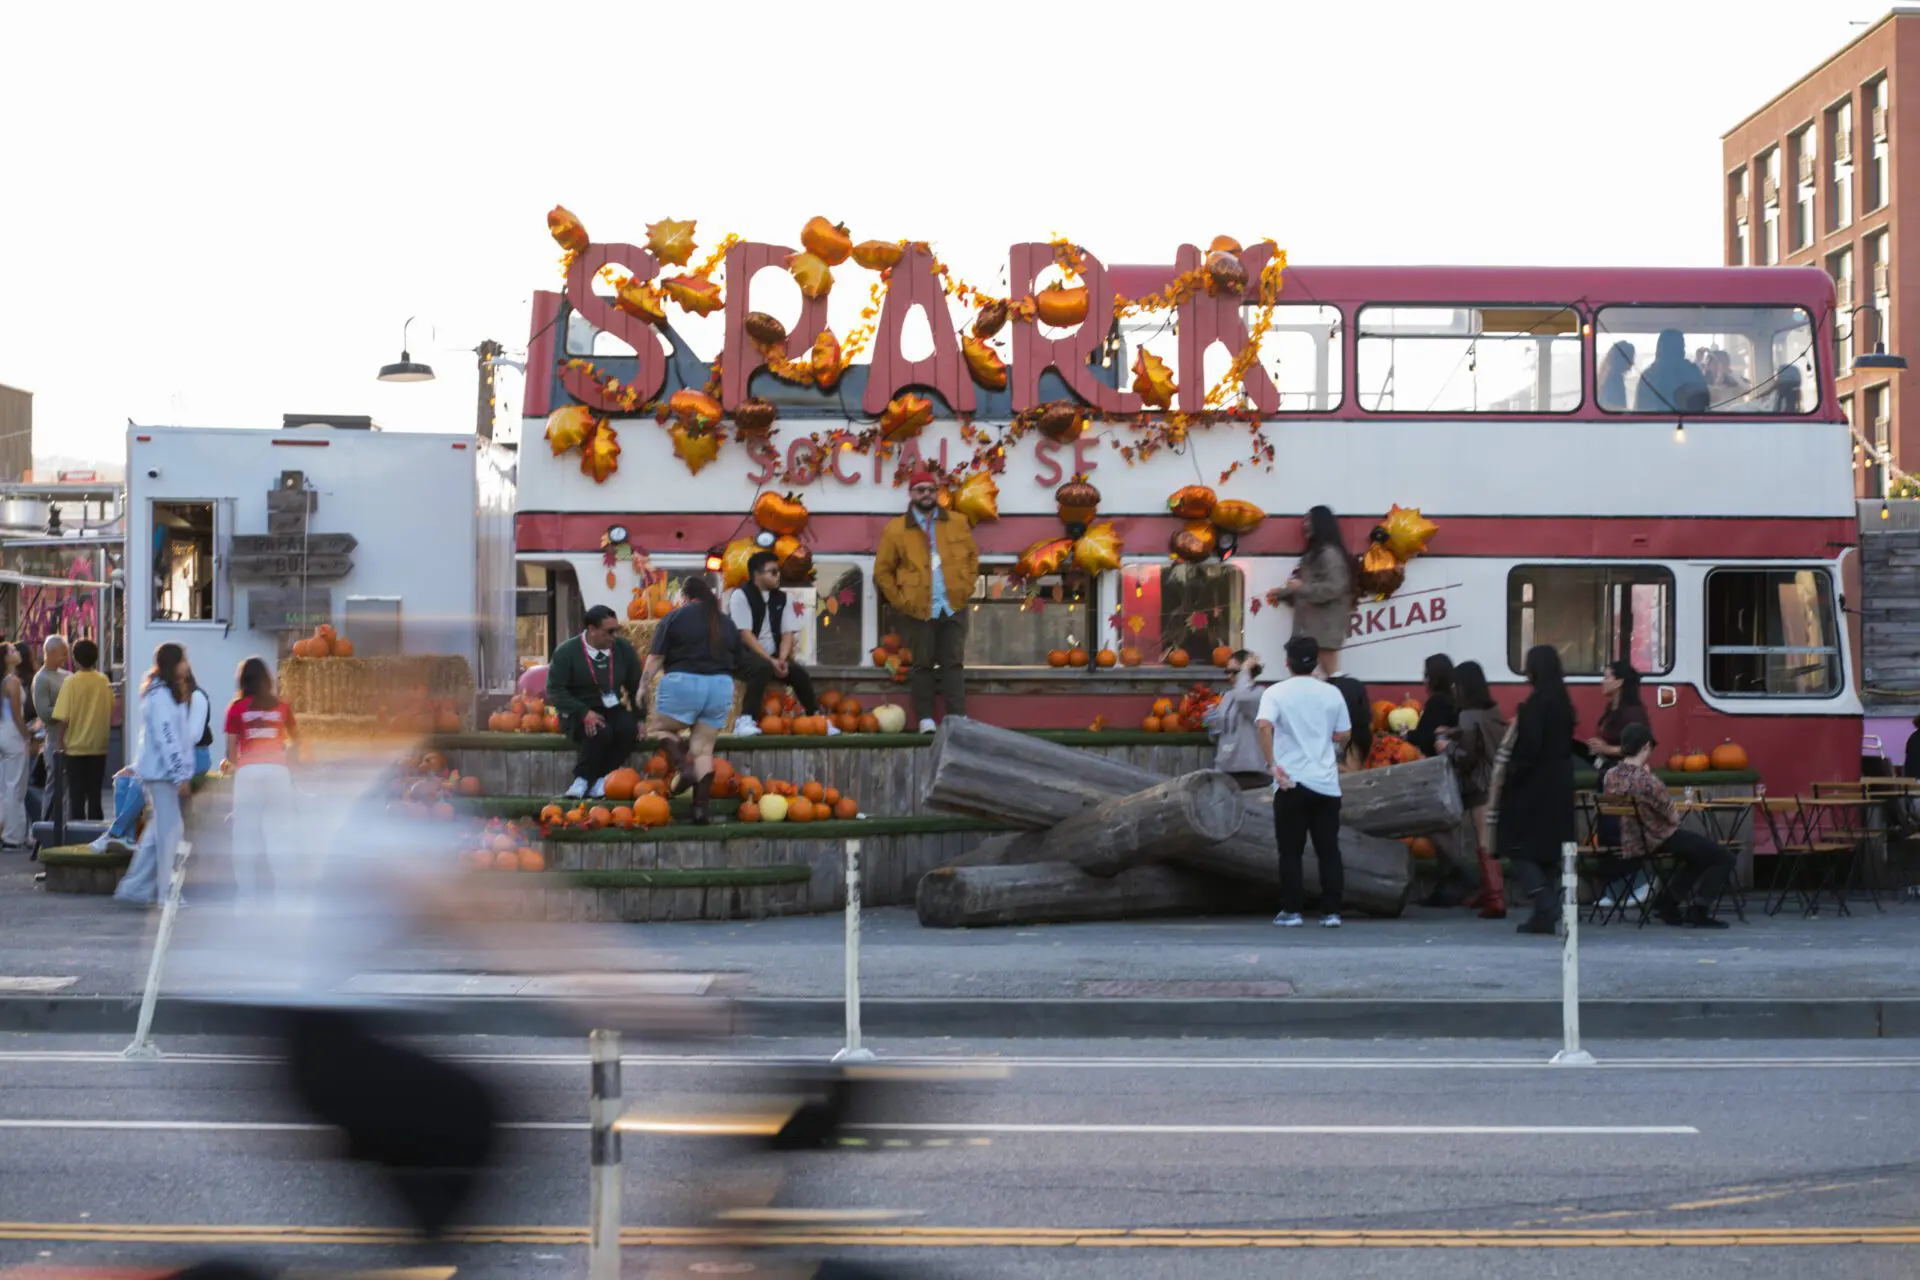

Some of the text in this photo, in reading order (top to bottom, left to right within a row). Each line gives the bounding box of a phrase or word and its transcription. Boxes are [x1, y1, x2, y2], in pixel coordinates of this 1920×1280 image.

[561, 242, 1281, 414] SPARK
[1034, 436, 1101, 487] SF
[1348, 598, 1446, 638] RKLAB
